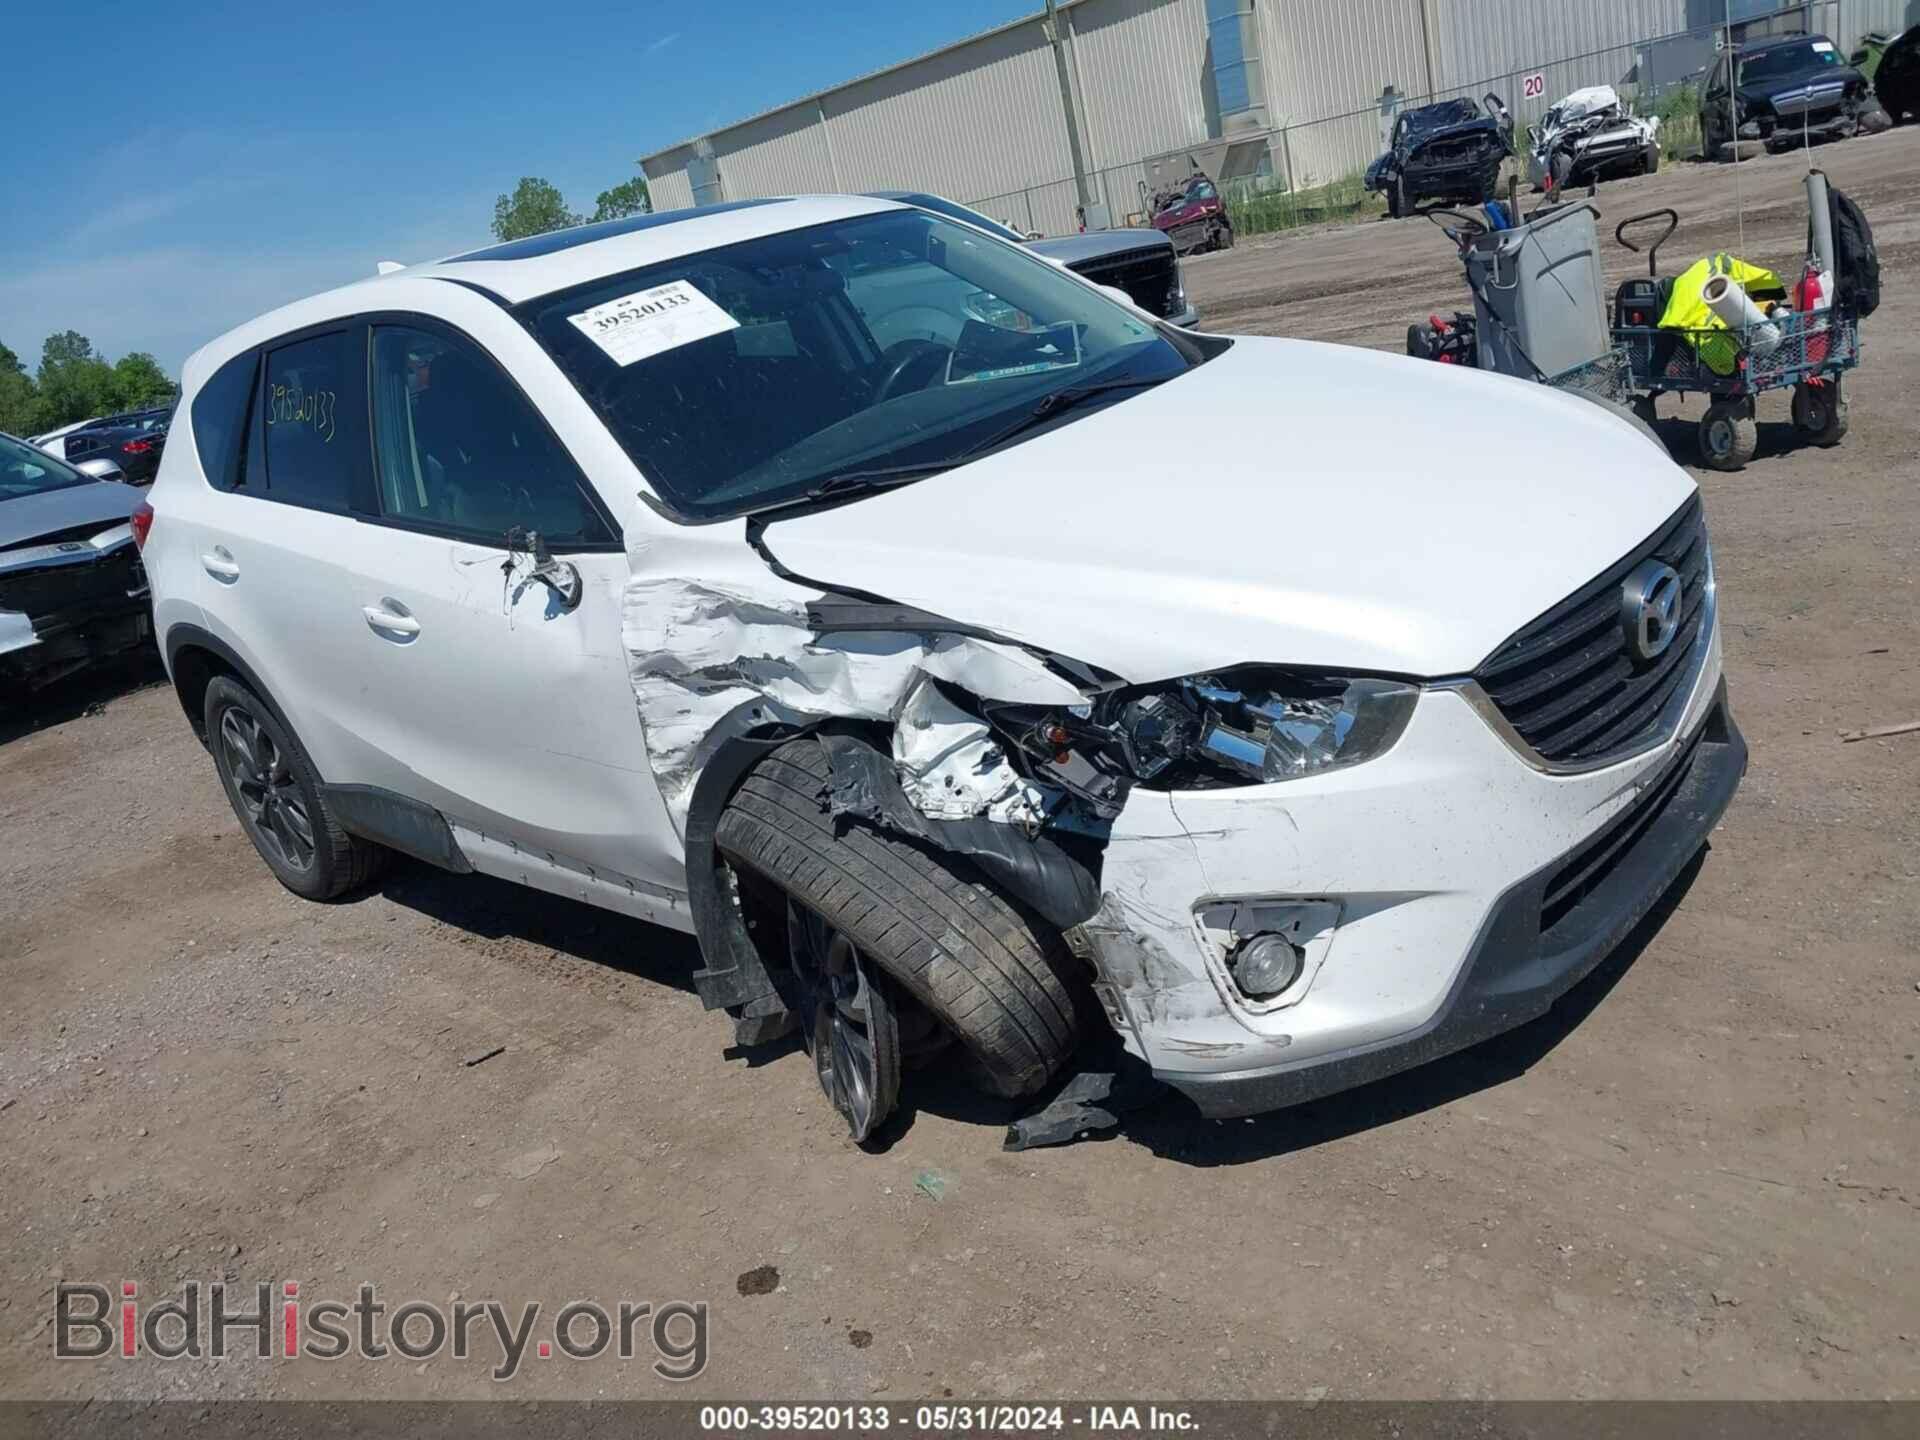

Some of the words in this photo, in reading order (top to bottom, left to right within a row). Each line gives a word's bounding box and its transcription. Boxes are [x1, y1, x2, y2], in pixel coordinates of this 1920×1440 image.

[1525, 76, 1543, 97] 20
[594, 293, 690, 332] 39520133
[266, 383, 336, 442] 39520133
